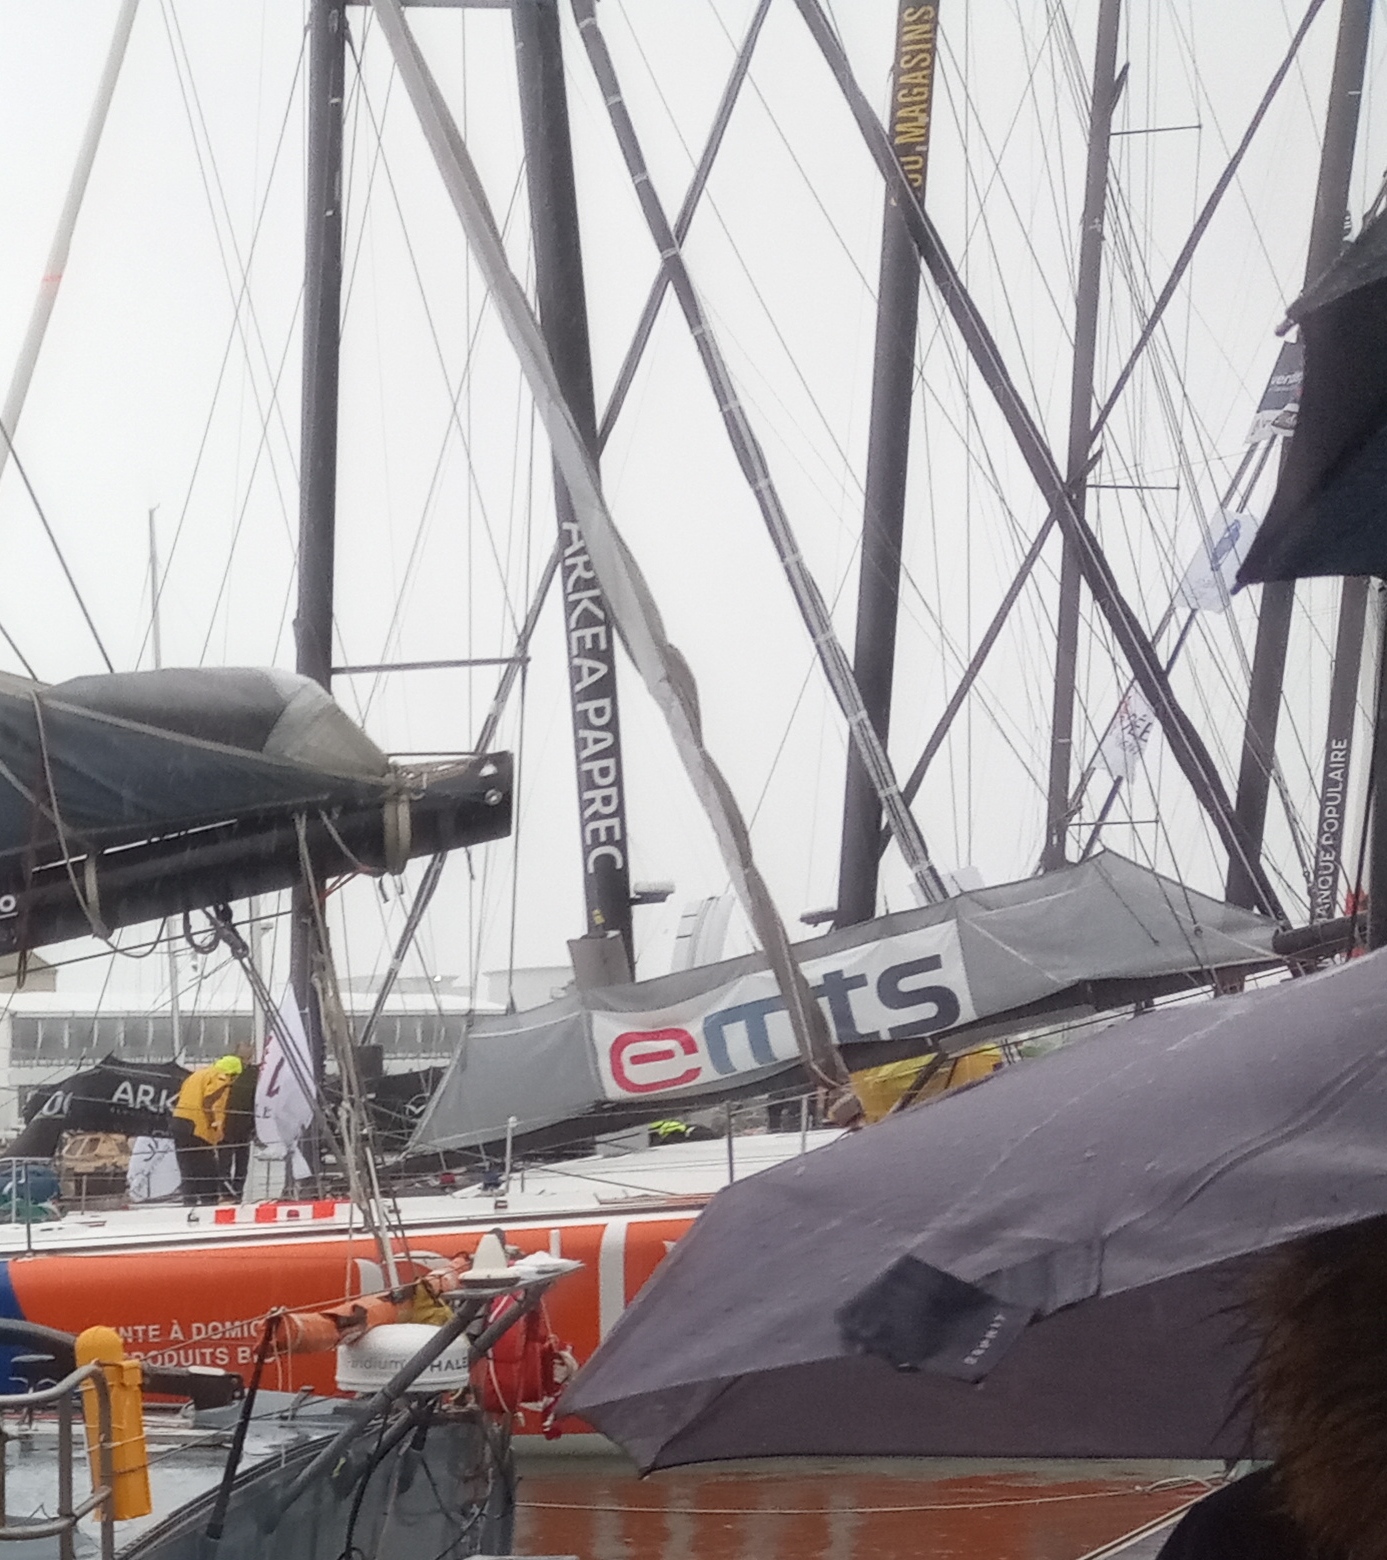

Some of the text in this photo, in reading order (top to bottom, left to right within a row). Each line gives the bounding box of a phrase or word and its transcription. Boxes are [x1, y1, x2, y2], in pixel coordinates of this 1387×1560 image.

[894, 5, 934, 145] MAGASINS
[562, 522, 624, 874] ARKEA PAPREC
[1316, 738, 1347, 923] ANQUE POPULAIRE
[113, 1324, 161, 1344] NTE
